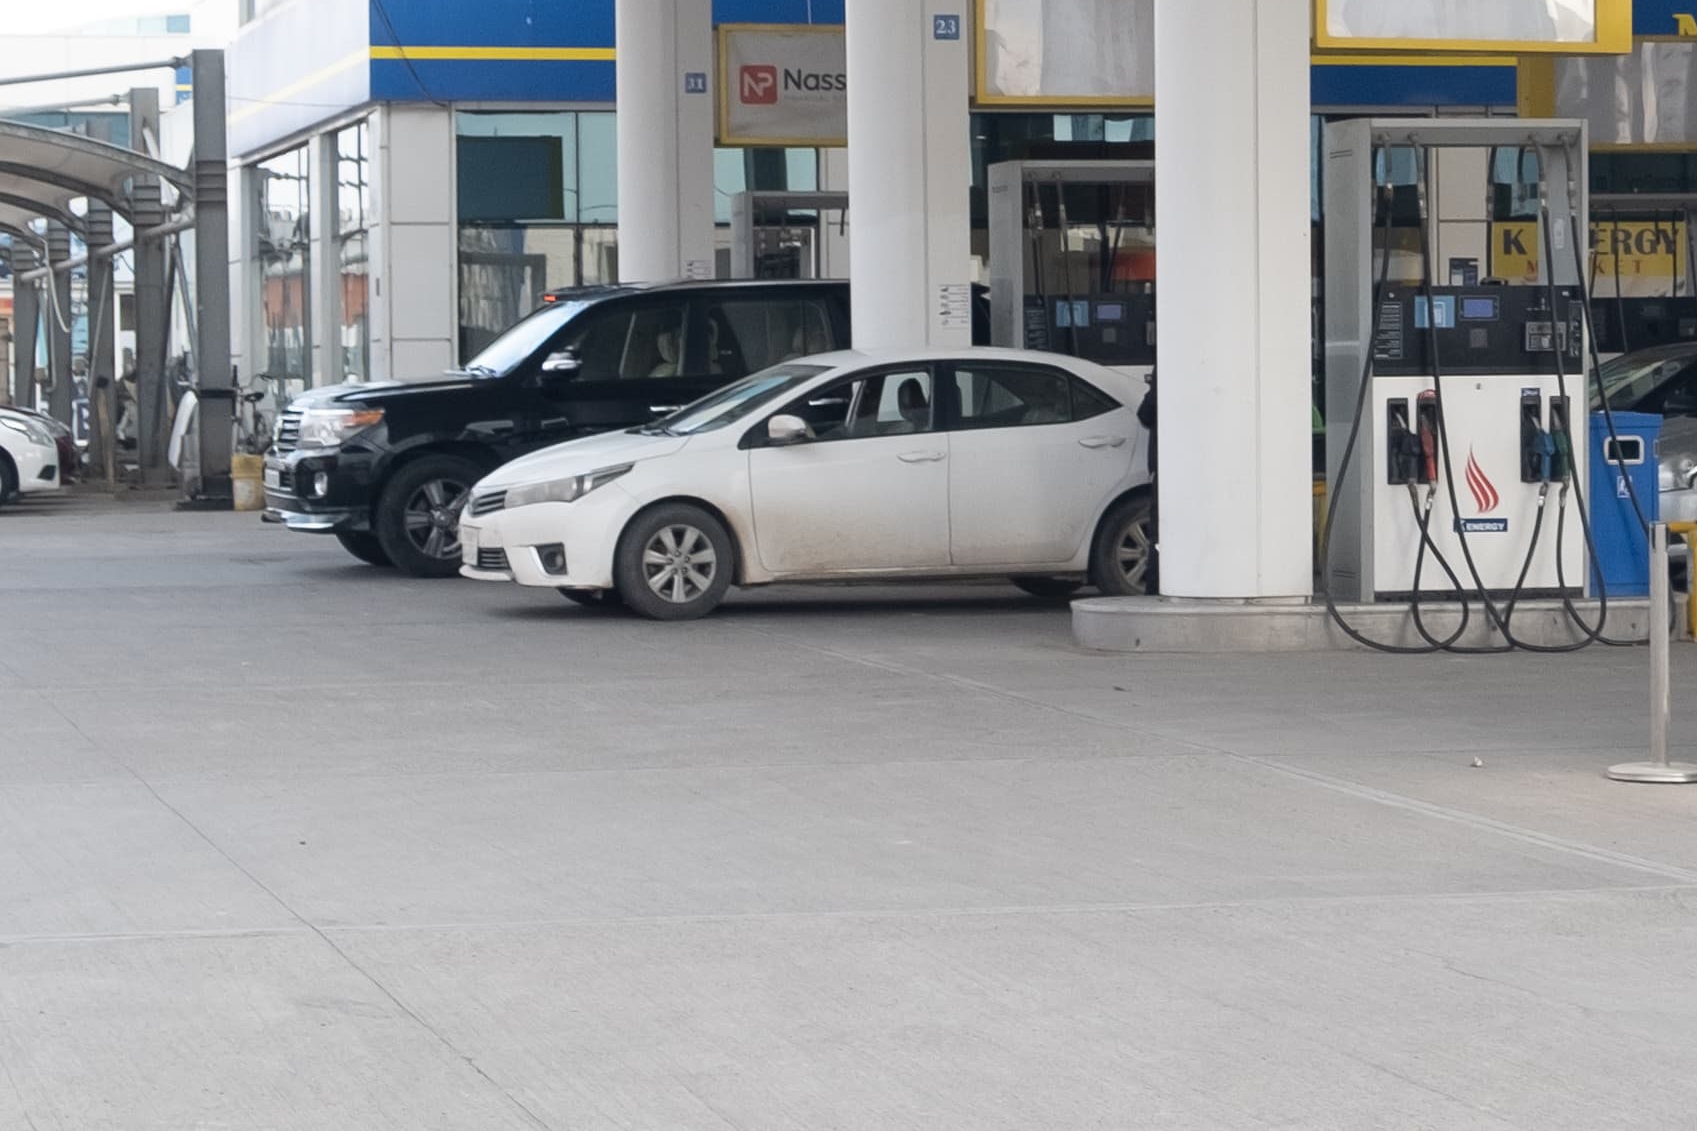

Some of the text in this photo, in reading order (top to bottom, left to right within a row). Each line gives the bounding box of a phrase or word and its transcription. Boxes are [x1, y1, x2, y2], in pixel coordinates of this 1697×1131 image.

[935, 19, 956, 35] 23
[784, 68, 847, 91] Nass
[1502, 228, 1527, 255] K
